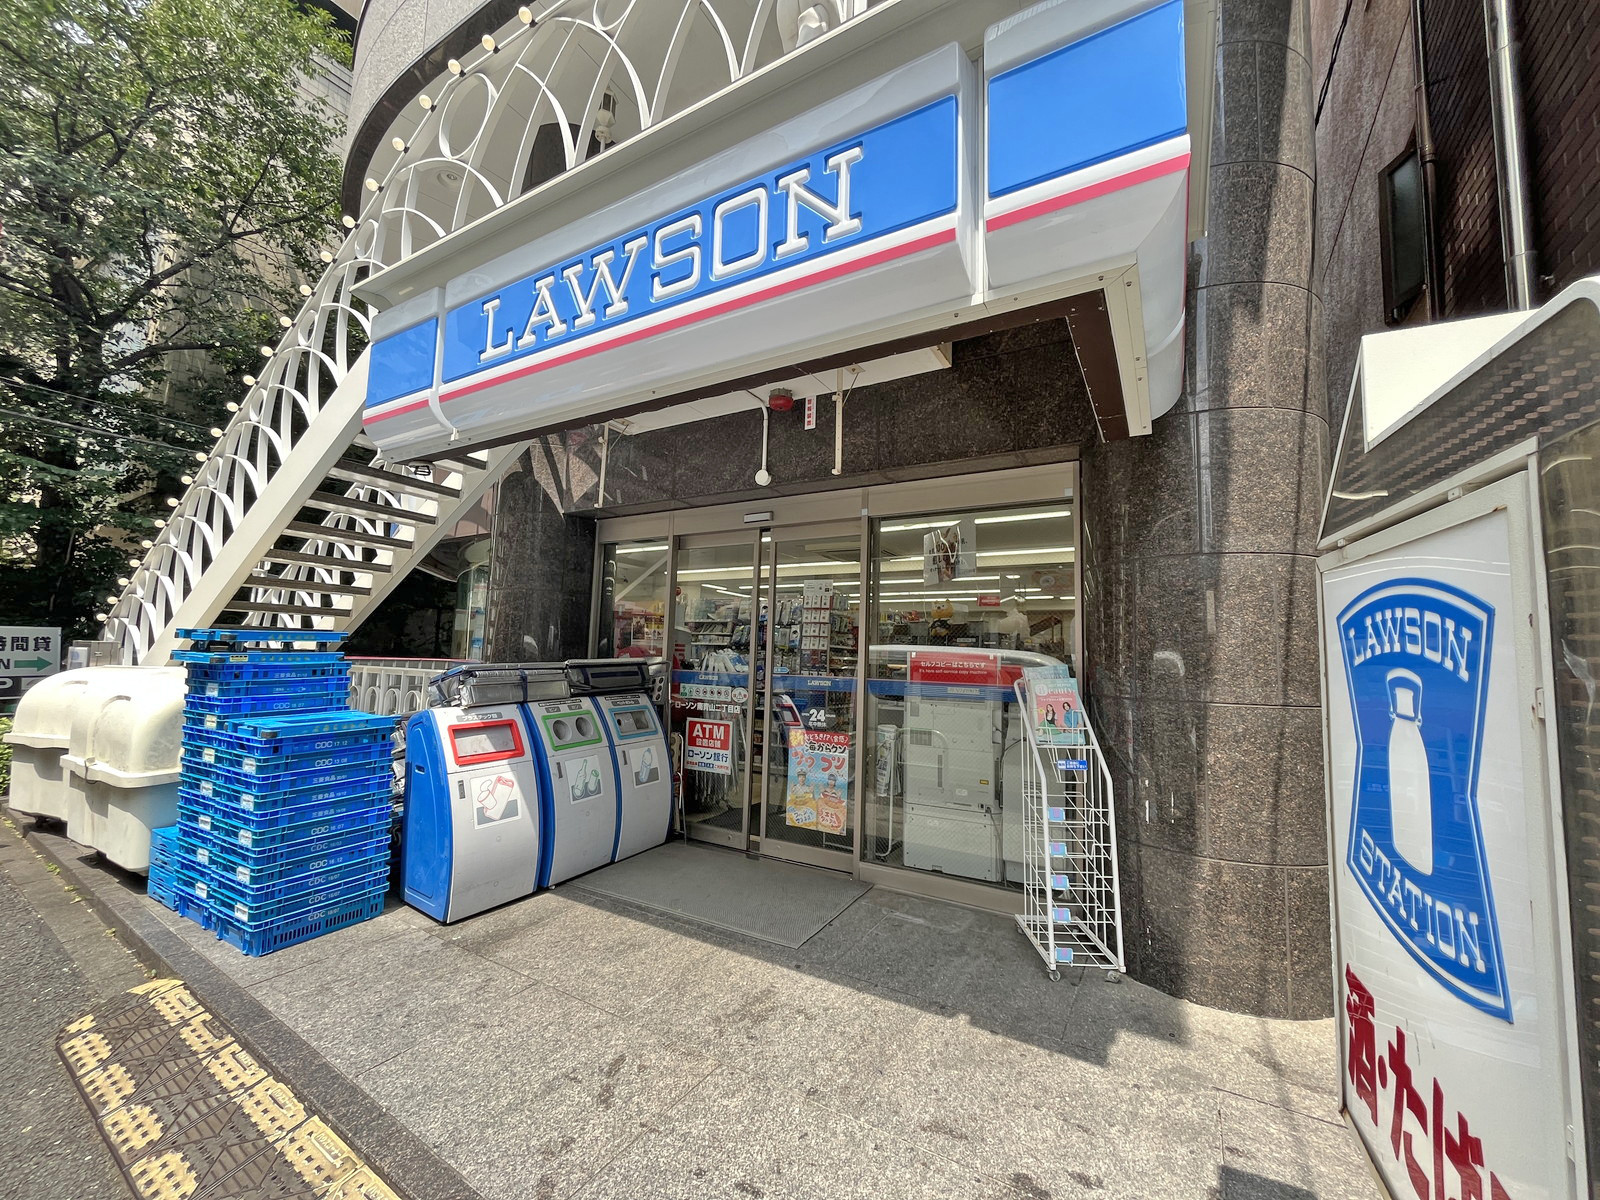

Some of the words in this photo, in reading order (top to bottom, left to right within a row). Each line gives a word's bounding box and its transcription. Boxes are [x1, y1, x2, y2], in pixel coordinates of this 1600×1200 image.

[478, 145, 863, 363] LAWSON
[1347, 607, 1473, 683] LAWSON
[920, 661, 987, 669] セルフコピーはこちらです
[273, 702, 291, 710] CDC
[809, 708, 826, 722] 24
[692, 723, 725, 740] ATM
[315, 740, 333, 749] CDC
[687, 749, 729, 763] ローソン銀行
[315, 758, 333, 768] CDC
[311, 825, 330, 835] CDC
[310, 842, 329, 852] CDC
[309, 859, 328, 870] CDC
[308, 876, 327, 886] CDC
[308, 893, 327, 904] CDC
[1360, 828, 1487, 974] STATION
[307, 910, 327, 921] CDC
